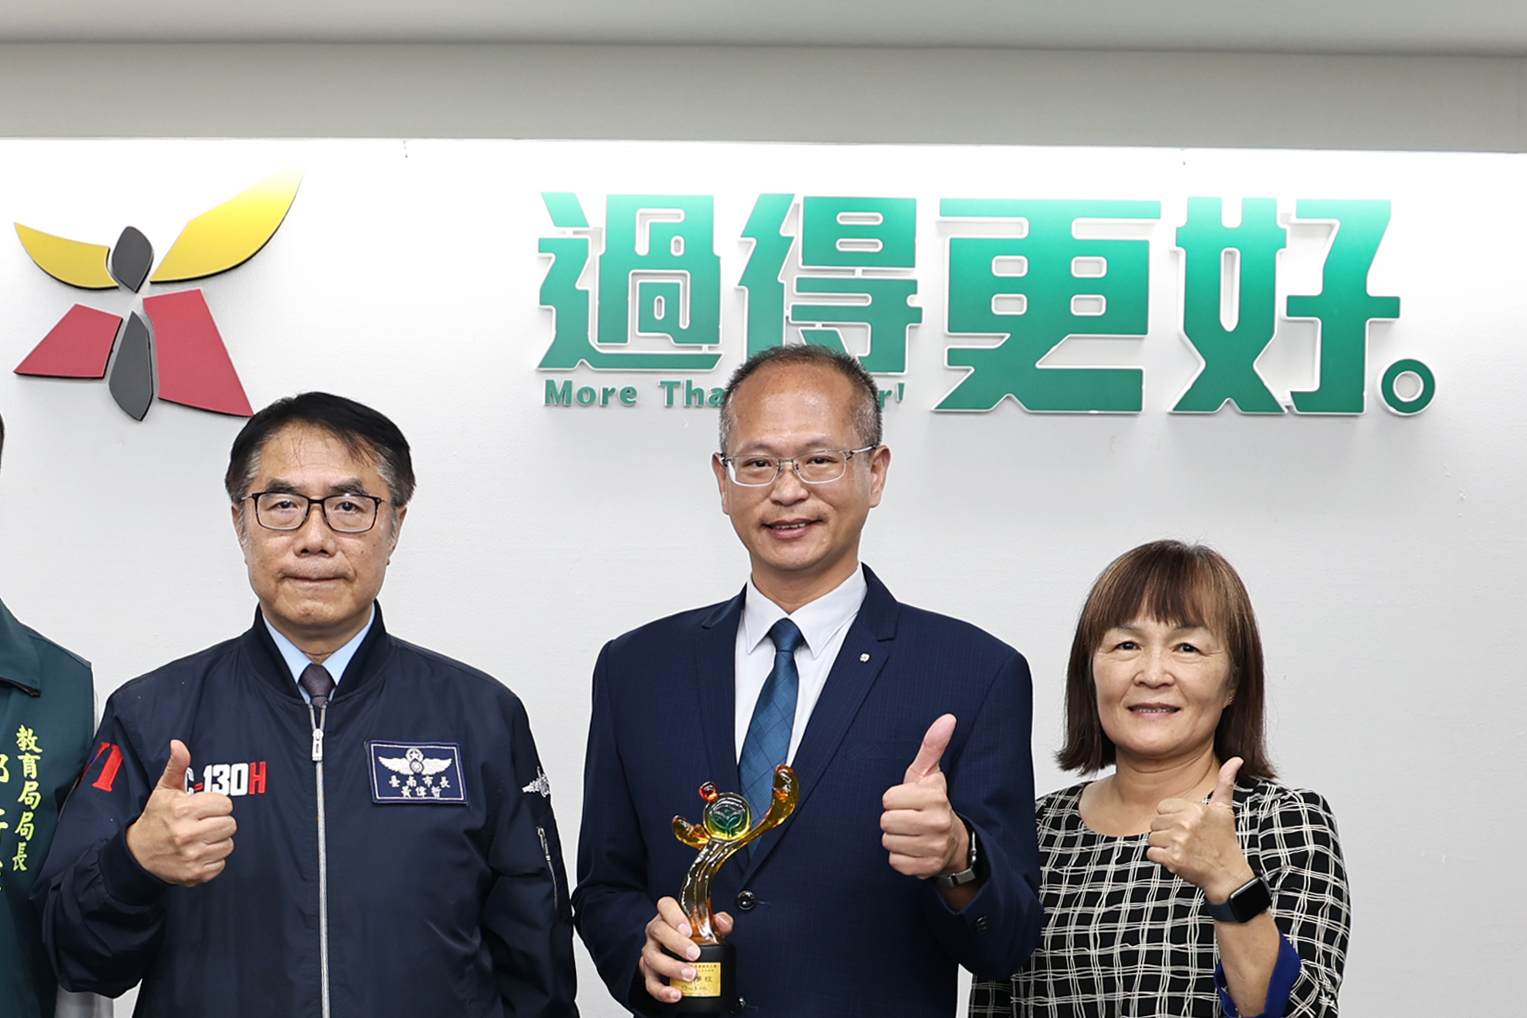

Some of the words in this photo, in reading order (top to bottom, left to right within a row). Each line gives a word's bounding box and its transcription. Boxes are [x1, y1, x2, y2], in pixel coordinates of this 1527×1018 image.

[536, 191, 1437, 417] 過得更好。
[543, 378, 639, 408] More
[657, 378, 724, 408] Tha
[12, 724, 43, 871] 教育局局長
